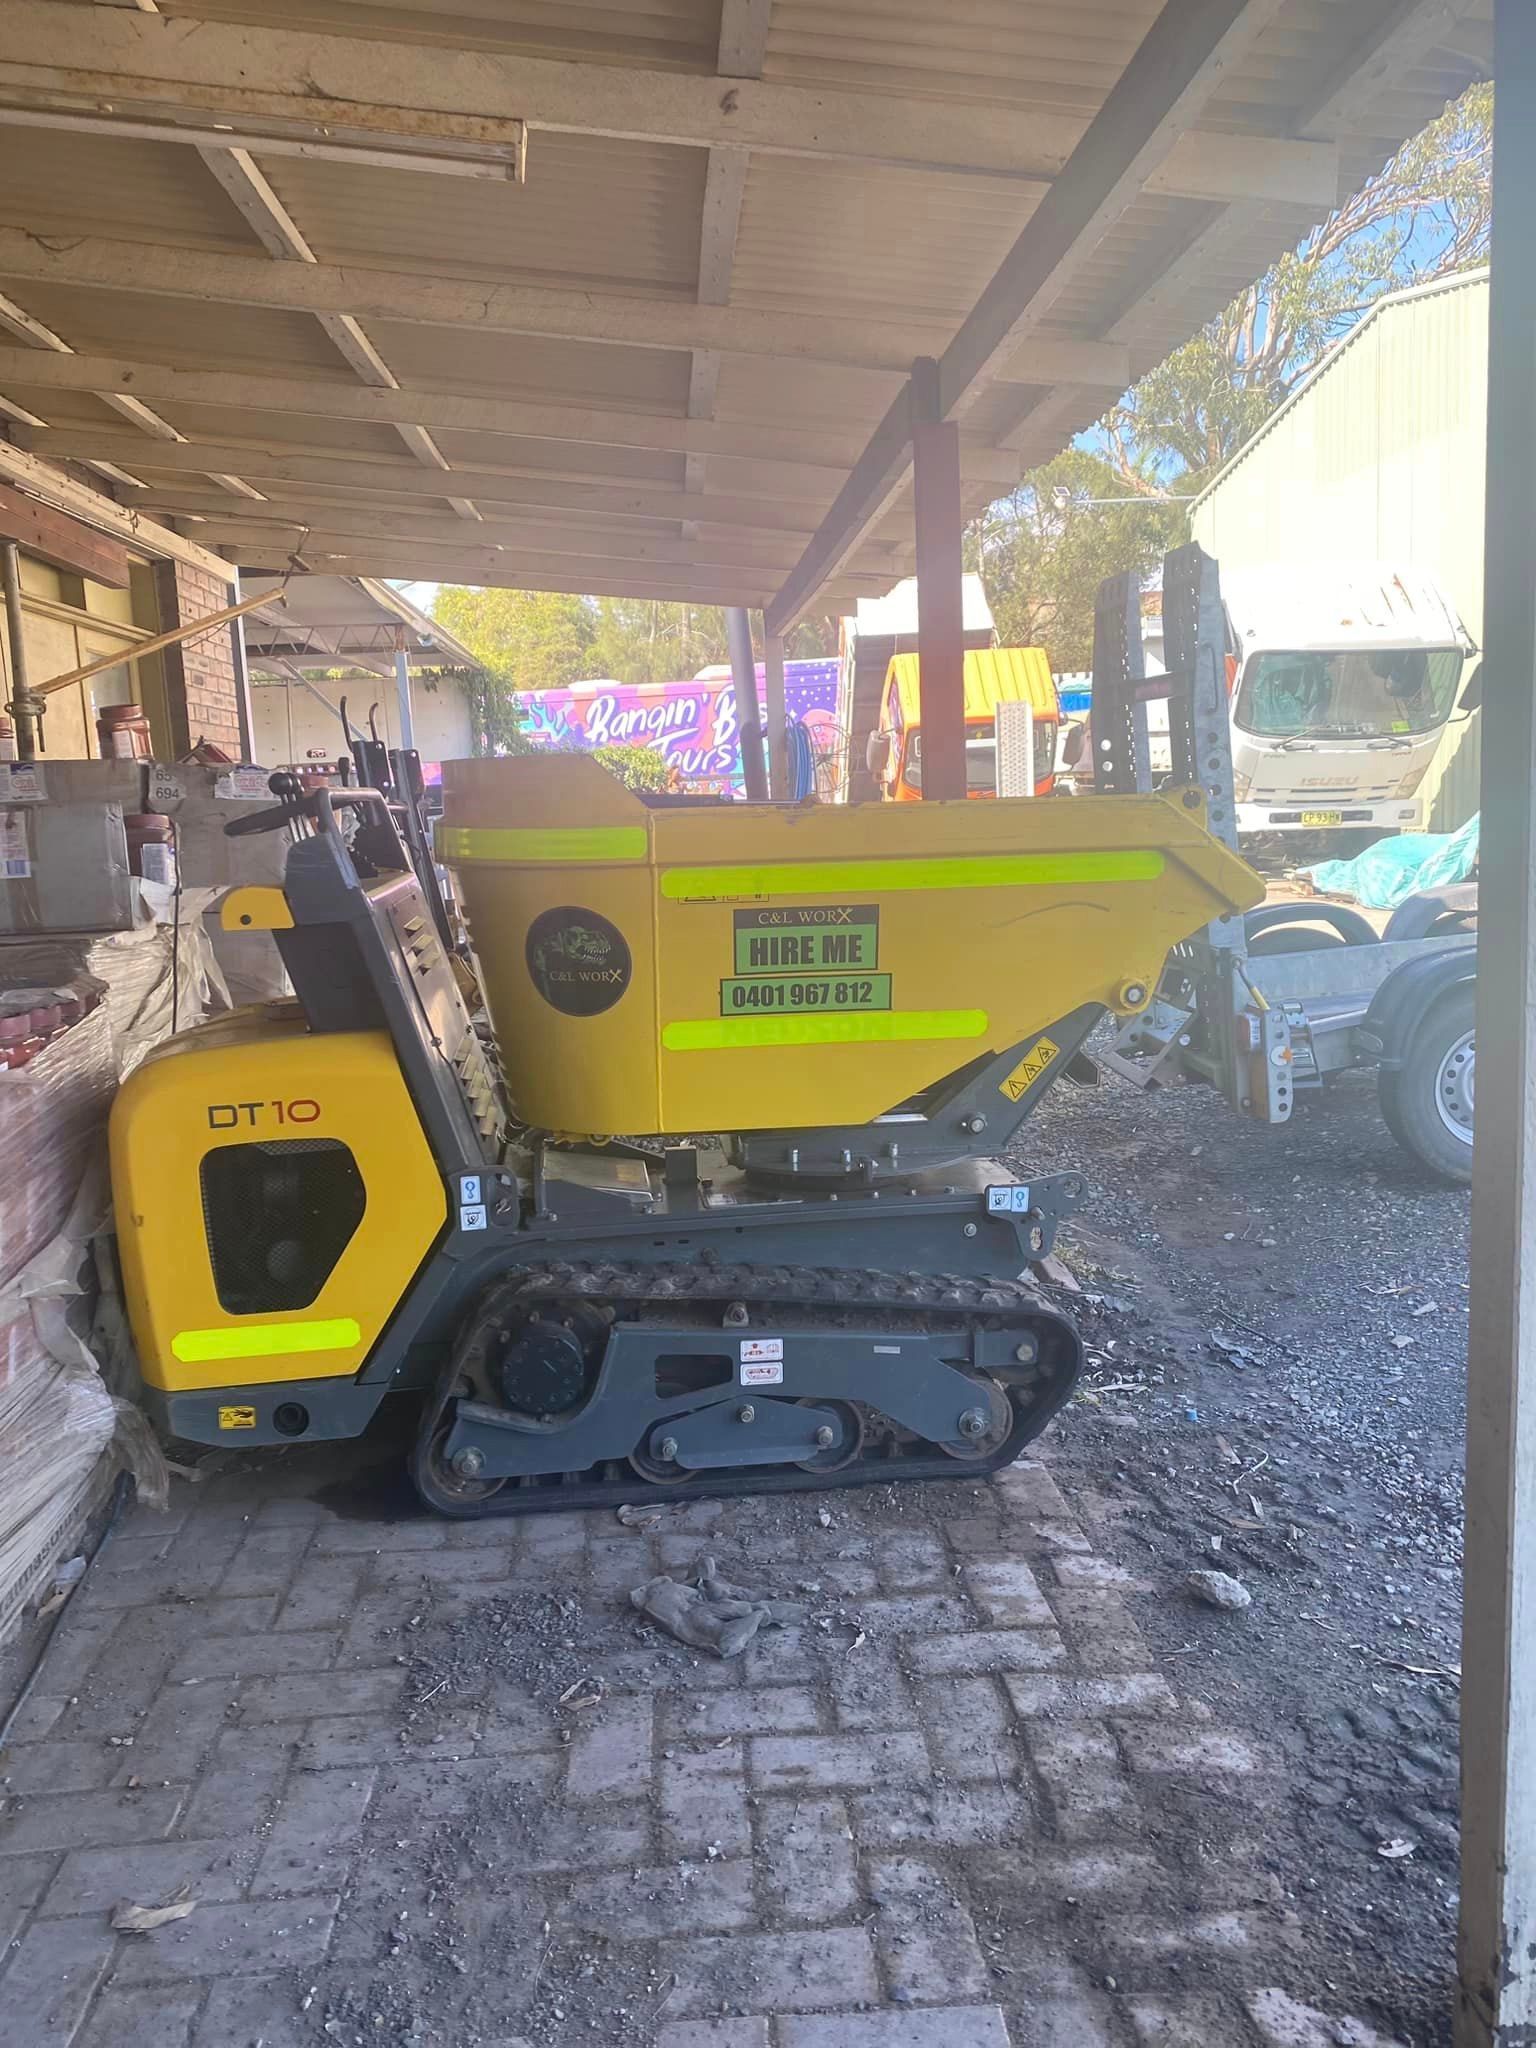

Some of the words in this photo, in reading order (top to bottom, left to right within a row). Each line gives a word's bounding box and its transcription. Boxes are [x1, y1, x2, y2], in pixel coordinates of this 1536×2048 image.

[647, 728, 732, 773] Tours
[1301, 776, 1359, 787] ISUZU
[155, 786, 180, 800] 694
[758, 911, 793, 925] C&L
[798, 907, 853, 925] WORX
[750, 935, 815, 967] HIRE
[821, 934, 862, 964] ME
[550, 971, 576, 982] C&L
[579, 969, 623, 983] WORX
[732, 984, 785, 1008] 0401
[790, 983, 830, 1006] 967
[835, 981, 873, 1004] 812
